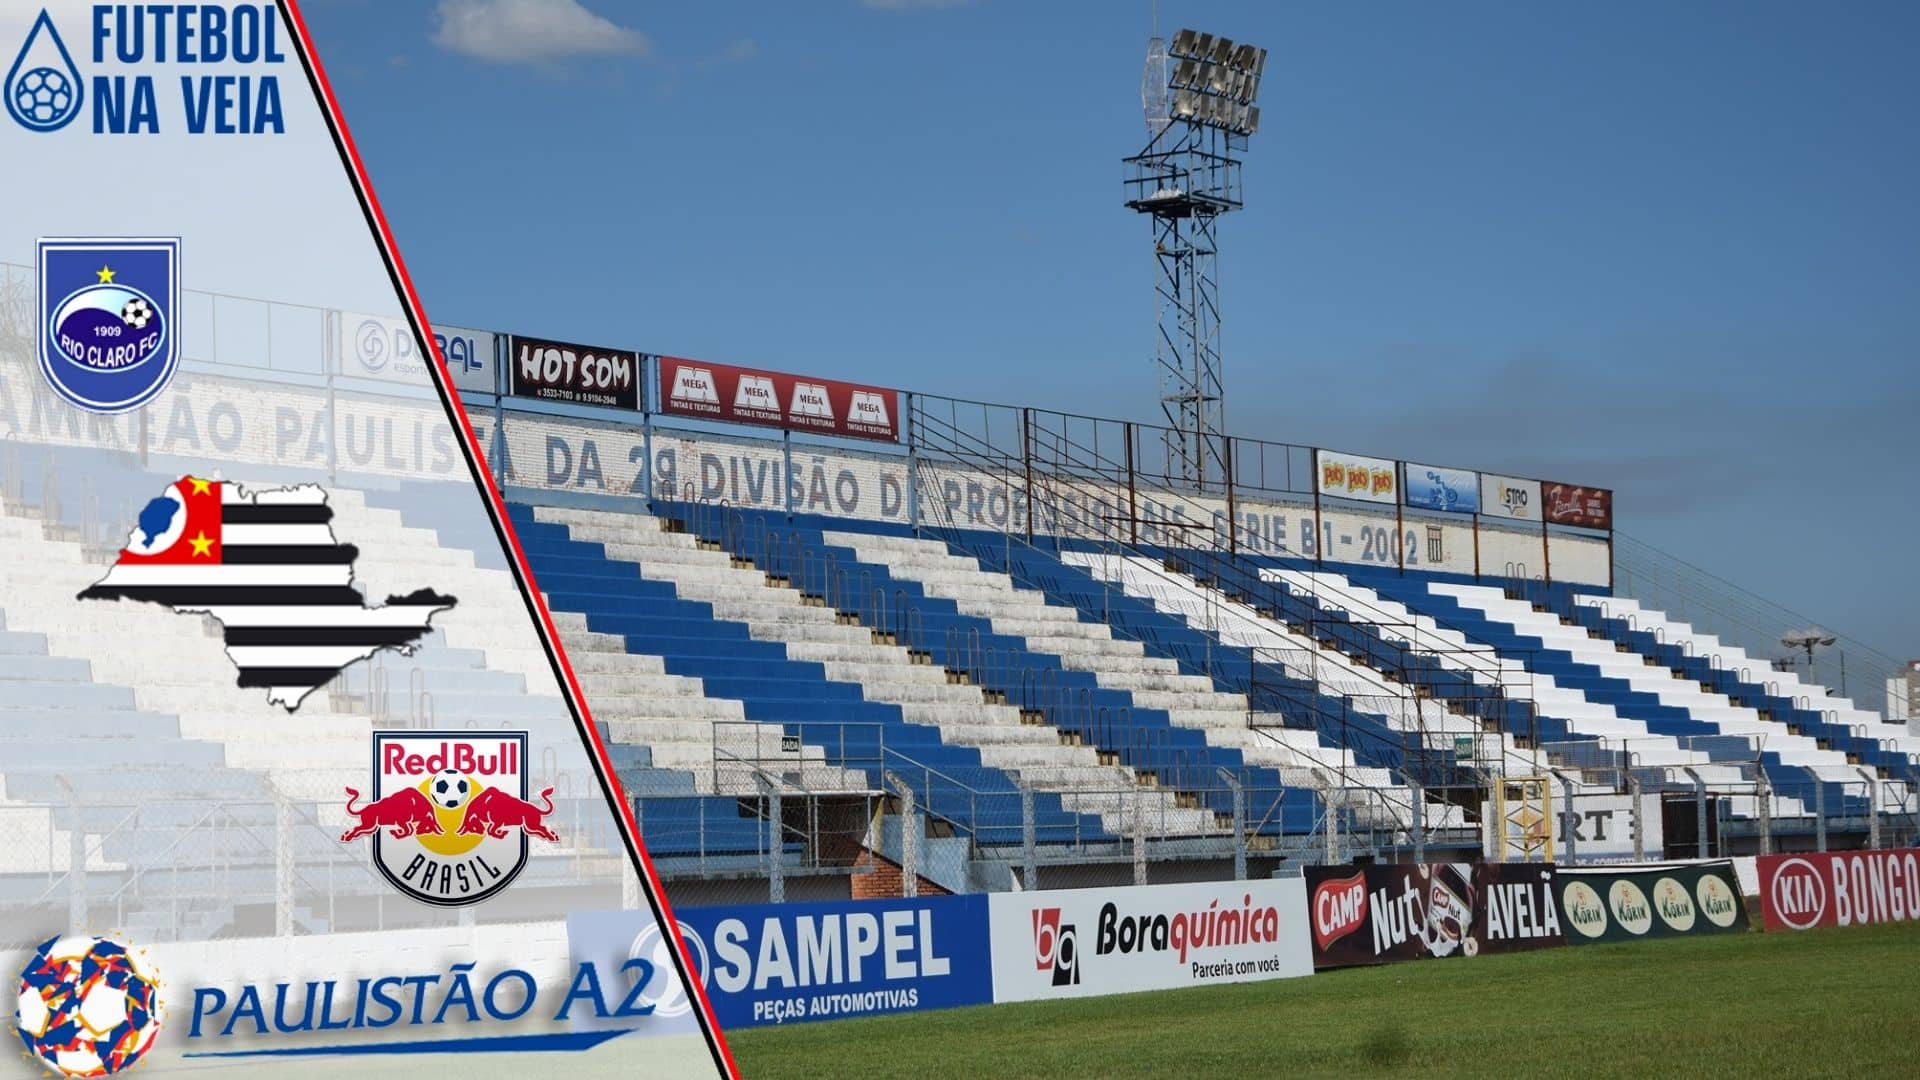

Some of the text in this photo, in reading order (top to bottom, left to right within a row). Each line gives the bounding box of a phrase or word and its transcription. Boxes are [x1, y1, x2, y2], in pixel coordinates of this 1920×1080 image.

[520, 345, 630, 388] HOT SOM
[682, 378, 708, 390] MEGA
[744, 387, 769, 399] MEGA
[670, 400, 689, 409] TINTAS
[799, 394, 823, 405] MEGA
[857, 402, 880, 413] MEGA
[733, 408, 752, 417] TINTAS
[789, 415, 806, 425] TINTAS
[847, 423, 863, 432] TINTAS
[276, 405, 515, 481] PAULISA
[545, 435, 604, 487] DA
[701, 451, 859, 513] DIVISÃO
[1360, 525, 1418, 565] 2002
[1831, 853, 1920, 927] BONGO
[1318, 884, 1364, 936] CAMP
[1487, 870, 1561, 939] AVELÃ
[1096, 894, 1279, 964] Boraquímica
[714, 909, 950, 993] SAMPEL
[1192, 954, 1280, 979] Parceria com você
[754, 988, 919, 1024] PEÇAS AUTOMOTIVAS
